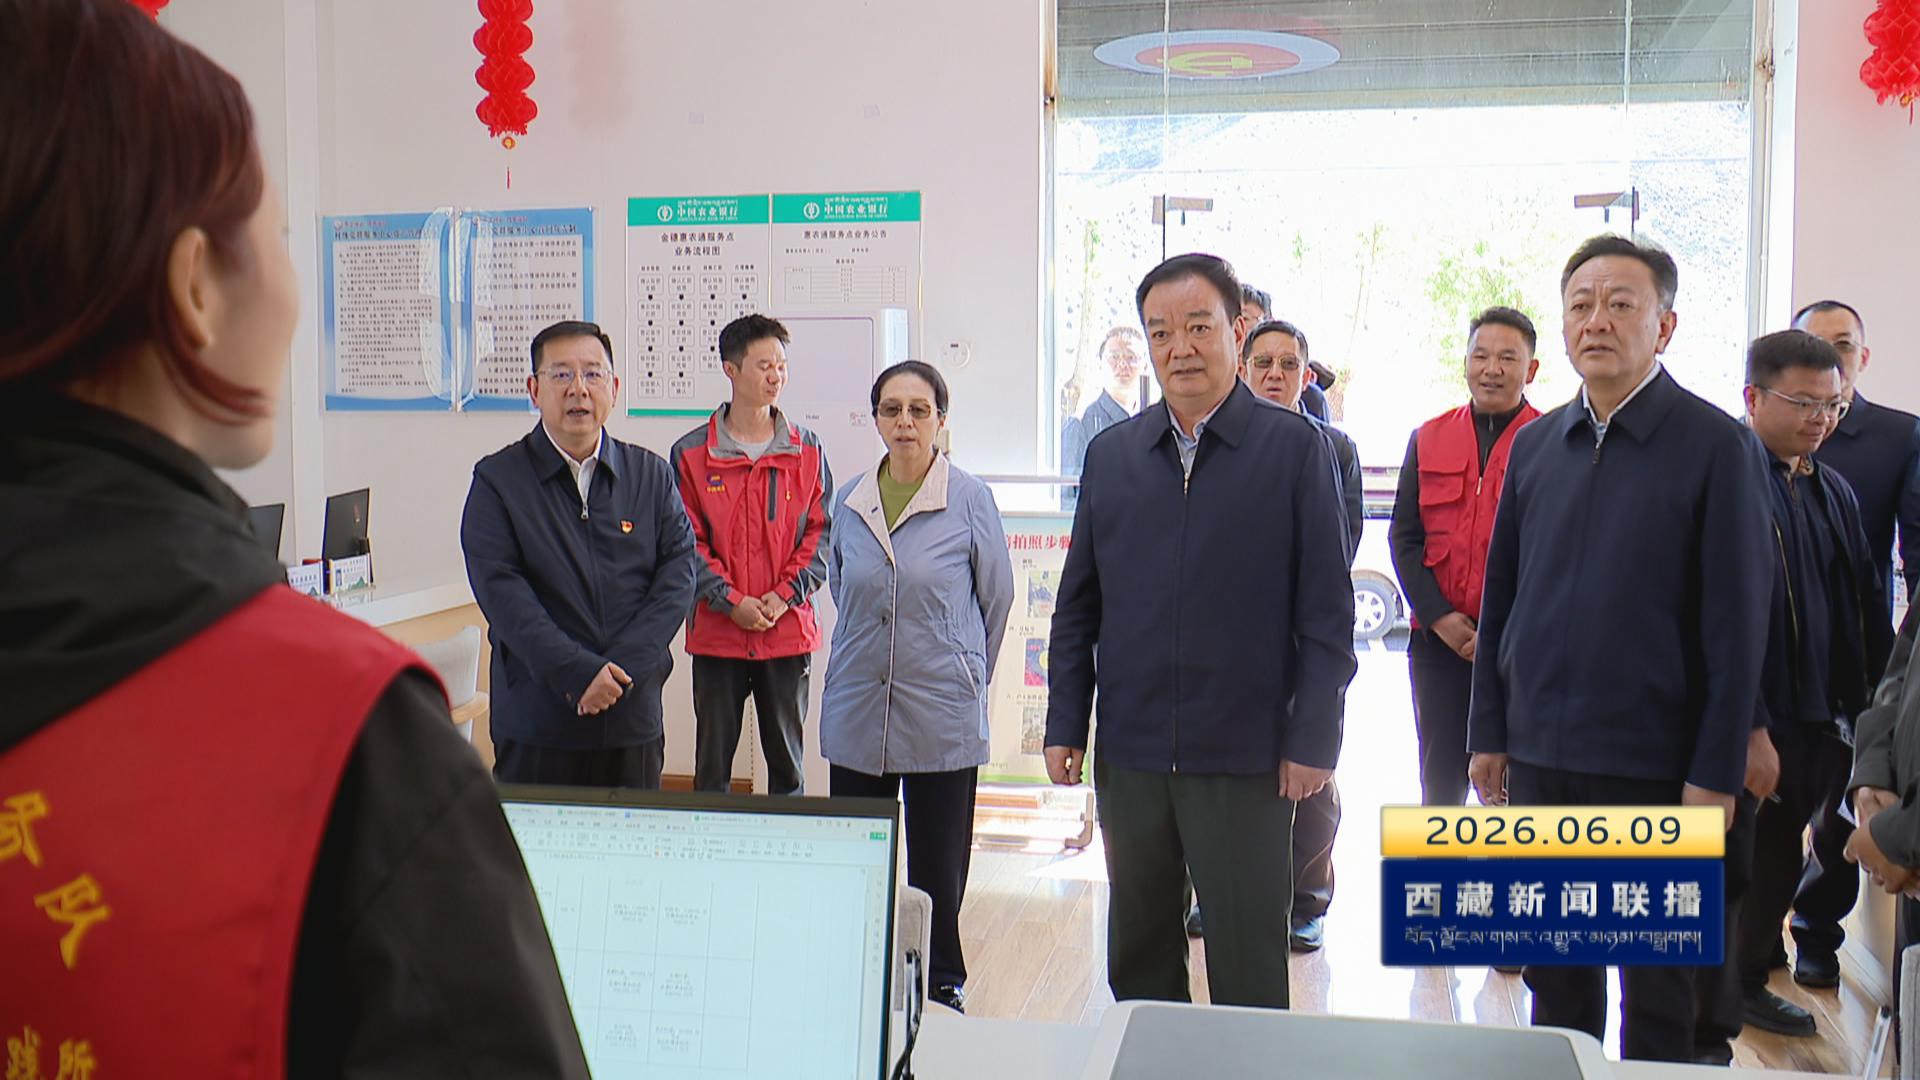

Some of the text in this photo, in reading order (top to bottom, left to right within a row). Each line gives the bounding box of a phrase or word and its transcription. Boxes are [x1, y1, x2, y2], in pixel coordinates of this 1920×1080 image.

[677, 205, 738, 217] 中国农业银行
[824, 203, 888, 214] 中国农业银行
[661, 232, 735, 242] 金穗惠农通服务点
[803, 229, 887, 240] 惠农通服务点业务公告
[674, 246, 721, 256] 业务流程图
